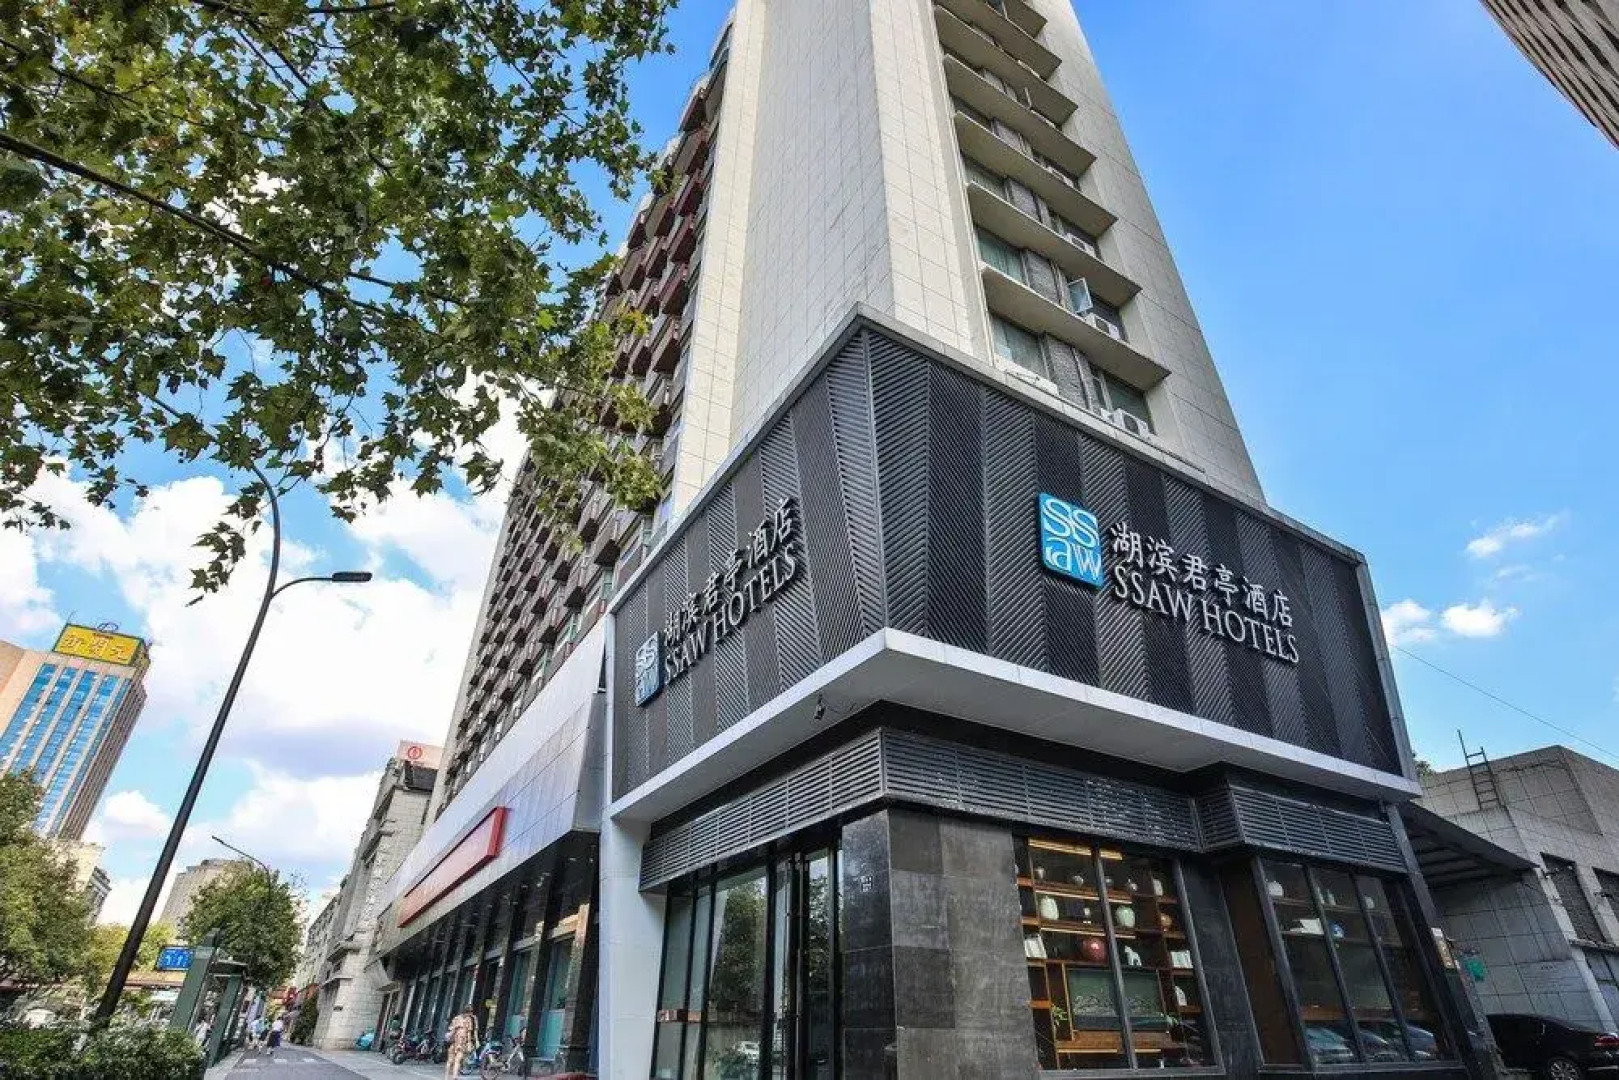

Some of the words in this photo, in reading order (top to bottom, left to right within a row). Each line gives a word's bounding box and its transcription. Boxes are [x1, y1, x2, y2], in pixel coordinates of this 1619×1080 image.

[664, 497, 797, 646] 湖滨君亭酒店
[664, 621, 707, 686] SSAW
[713, 545, 797, 643] HOTELS
[1110, 522, 1294, 629] 湖滨君亭酒店
[1113, 564, 1193, 624] SSAW
[1202, 597, 1299, 664] HOTELS
